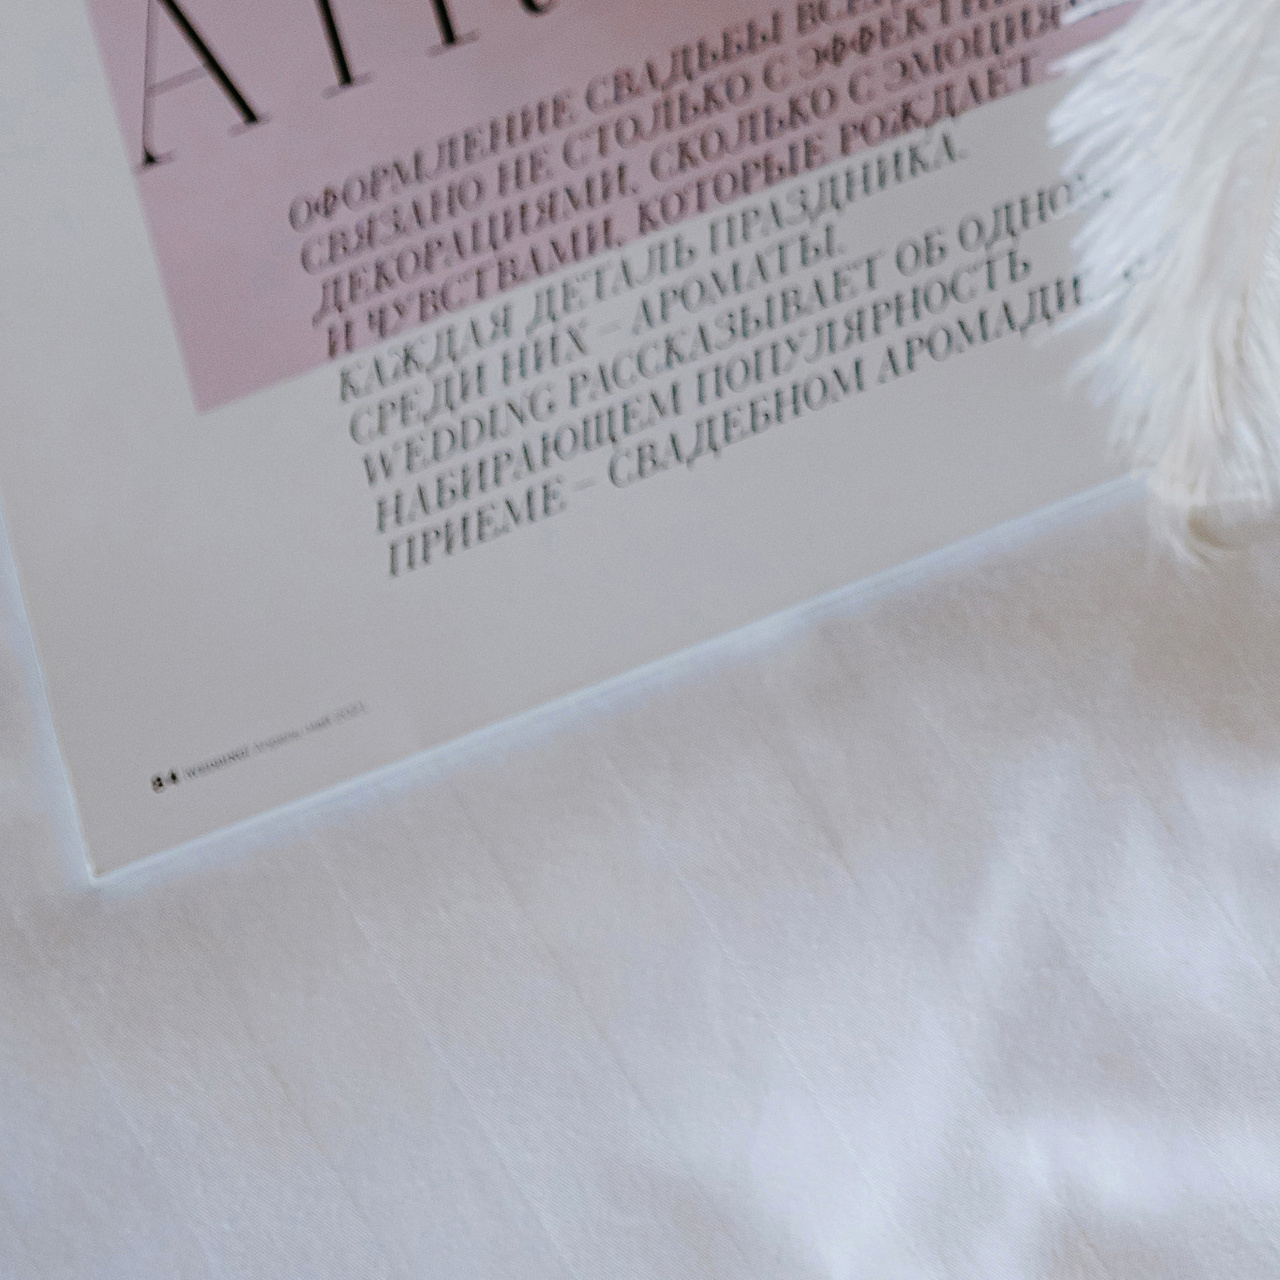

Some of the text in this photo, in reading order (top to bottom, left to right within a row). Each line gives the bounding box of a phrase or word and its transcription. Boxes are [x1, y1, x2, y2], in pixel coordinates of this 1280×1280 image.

[286, 89, 575, 232] ОФОРМЛЕНИЕ
[584, 8, 784, 114] СВАДЬБЫ
[298, 174, 488, 274] СВЯЗАНО
[496, 146, 553, 198] НЕ
[561, 69, 756, 170] СТОЛЬКО
[761, 53, 790, 91] С
[648, 82, 842, 181] СКОЛЬКО
[847, 66, 876, 105] С
[882, 3, 1061, 91] ЭМОЦИЯ
[326, 315, 355, 360] И
[636, 131, 828, 236] КОТОРЫЕ
[838, 49, 1039, 157] РОЖДАЕТ
[338, 301, 514, 404] КАЖДАЯ
[524, 232, 698, 336] ДЕТАЛЬ
[347, 359, 488, 445] СРЕДИ
[500, 318, 590, 387] НИХ
[361, 180, 1078, 488] WEDDING РАССКАЗЫВАЕТ ОБ ОДНО
[375, 244, 1033, 534] НАБИРАЮЩЕМ ПОПУЛЯРНОСТЬ
[387, 475, 567, 578] ПРИЕМЕ
[606, 355, 866, 488] СВАДЕБНОМ
[877, 274, 1083, 384] АРОМАДИ
